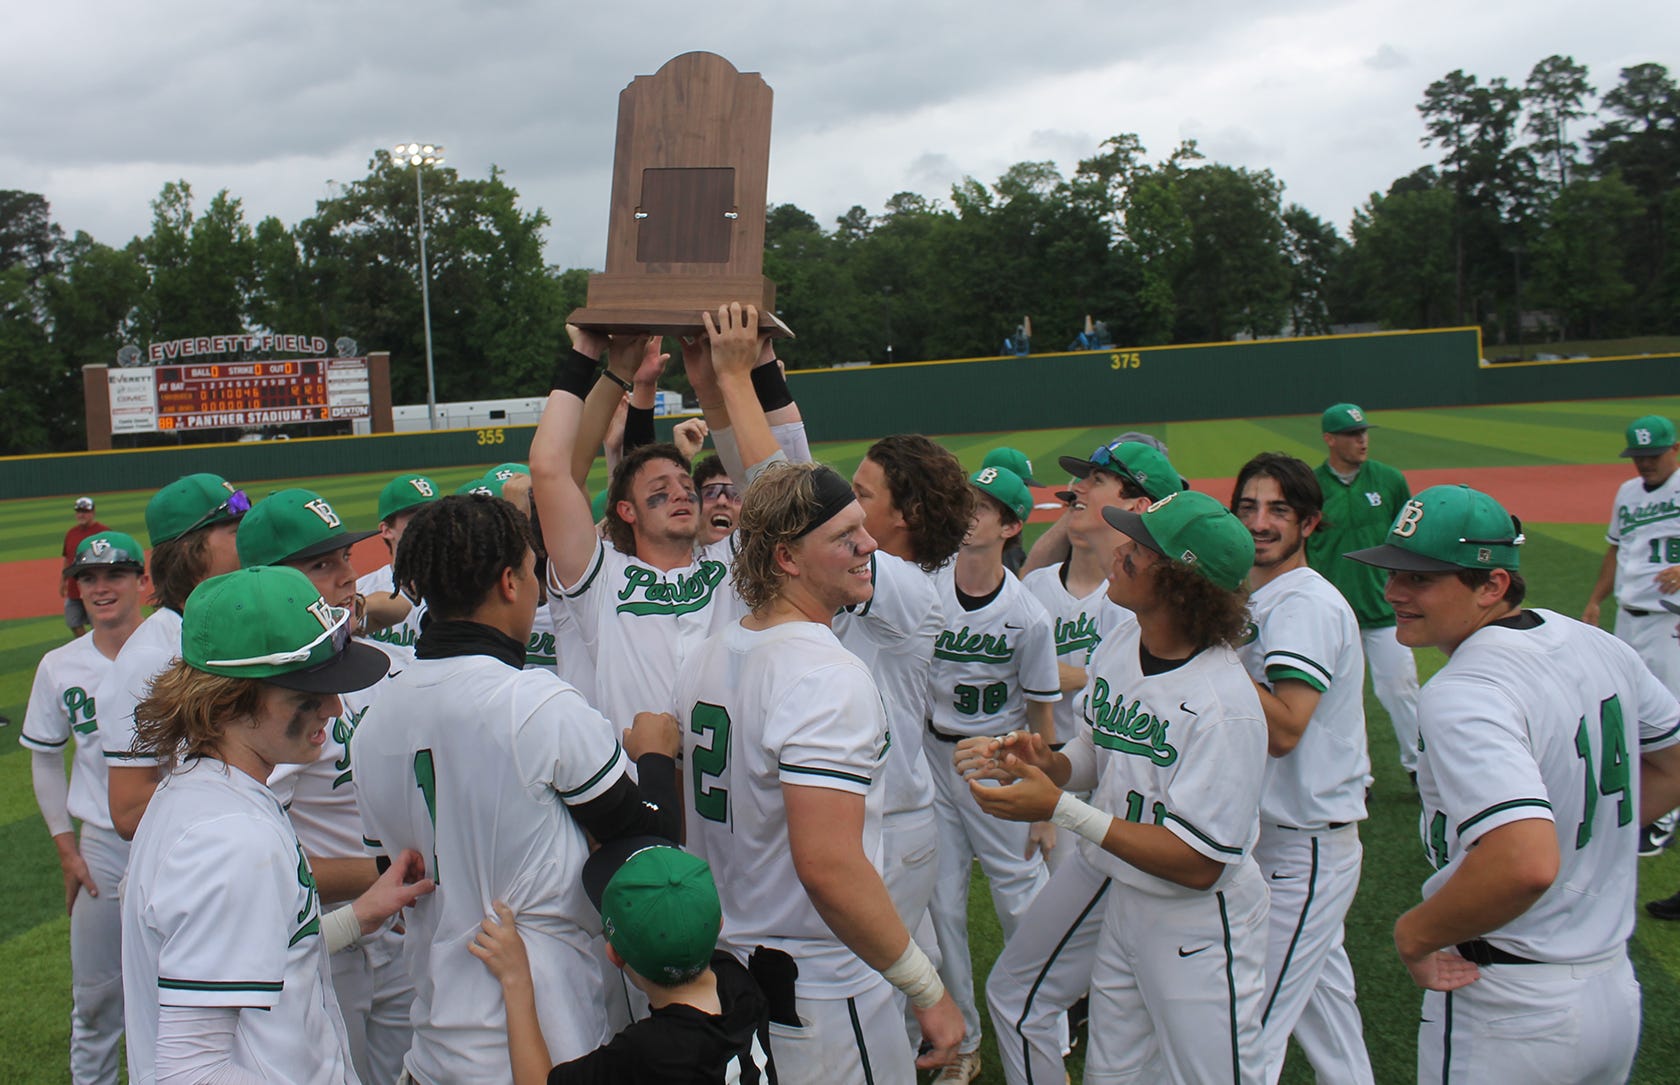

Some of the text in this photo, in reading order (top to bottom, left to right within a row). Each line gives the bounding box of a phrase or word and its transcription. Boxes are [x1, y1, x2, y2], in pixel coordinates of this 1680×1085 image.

[149, 333, 328, 362] EVERETT FIELD
[191, 361, 292, 378] BALL 0 STRIKE 0 OUT 0
[1110, 353, 1140, 370] 375
[108, 373, 152, 385] EVERETT
[158, 383, 168, 392] AT
[170, 382, 185, 392] BAT
[201, 382, 206, 390] 1
[187, 413, 245, 427] PANTHER
[247, 410, 302, 423] STADIUM
[320, 407, 328, 420] 2
[476, 429, 505, 446] 355
[953, 681, 1008, 715] 38
[1574, 693, 1633, 850] 14
